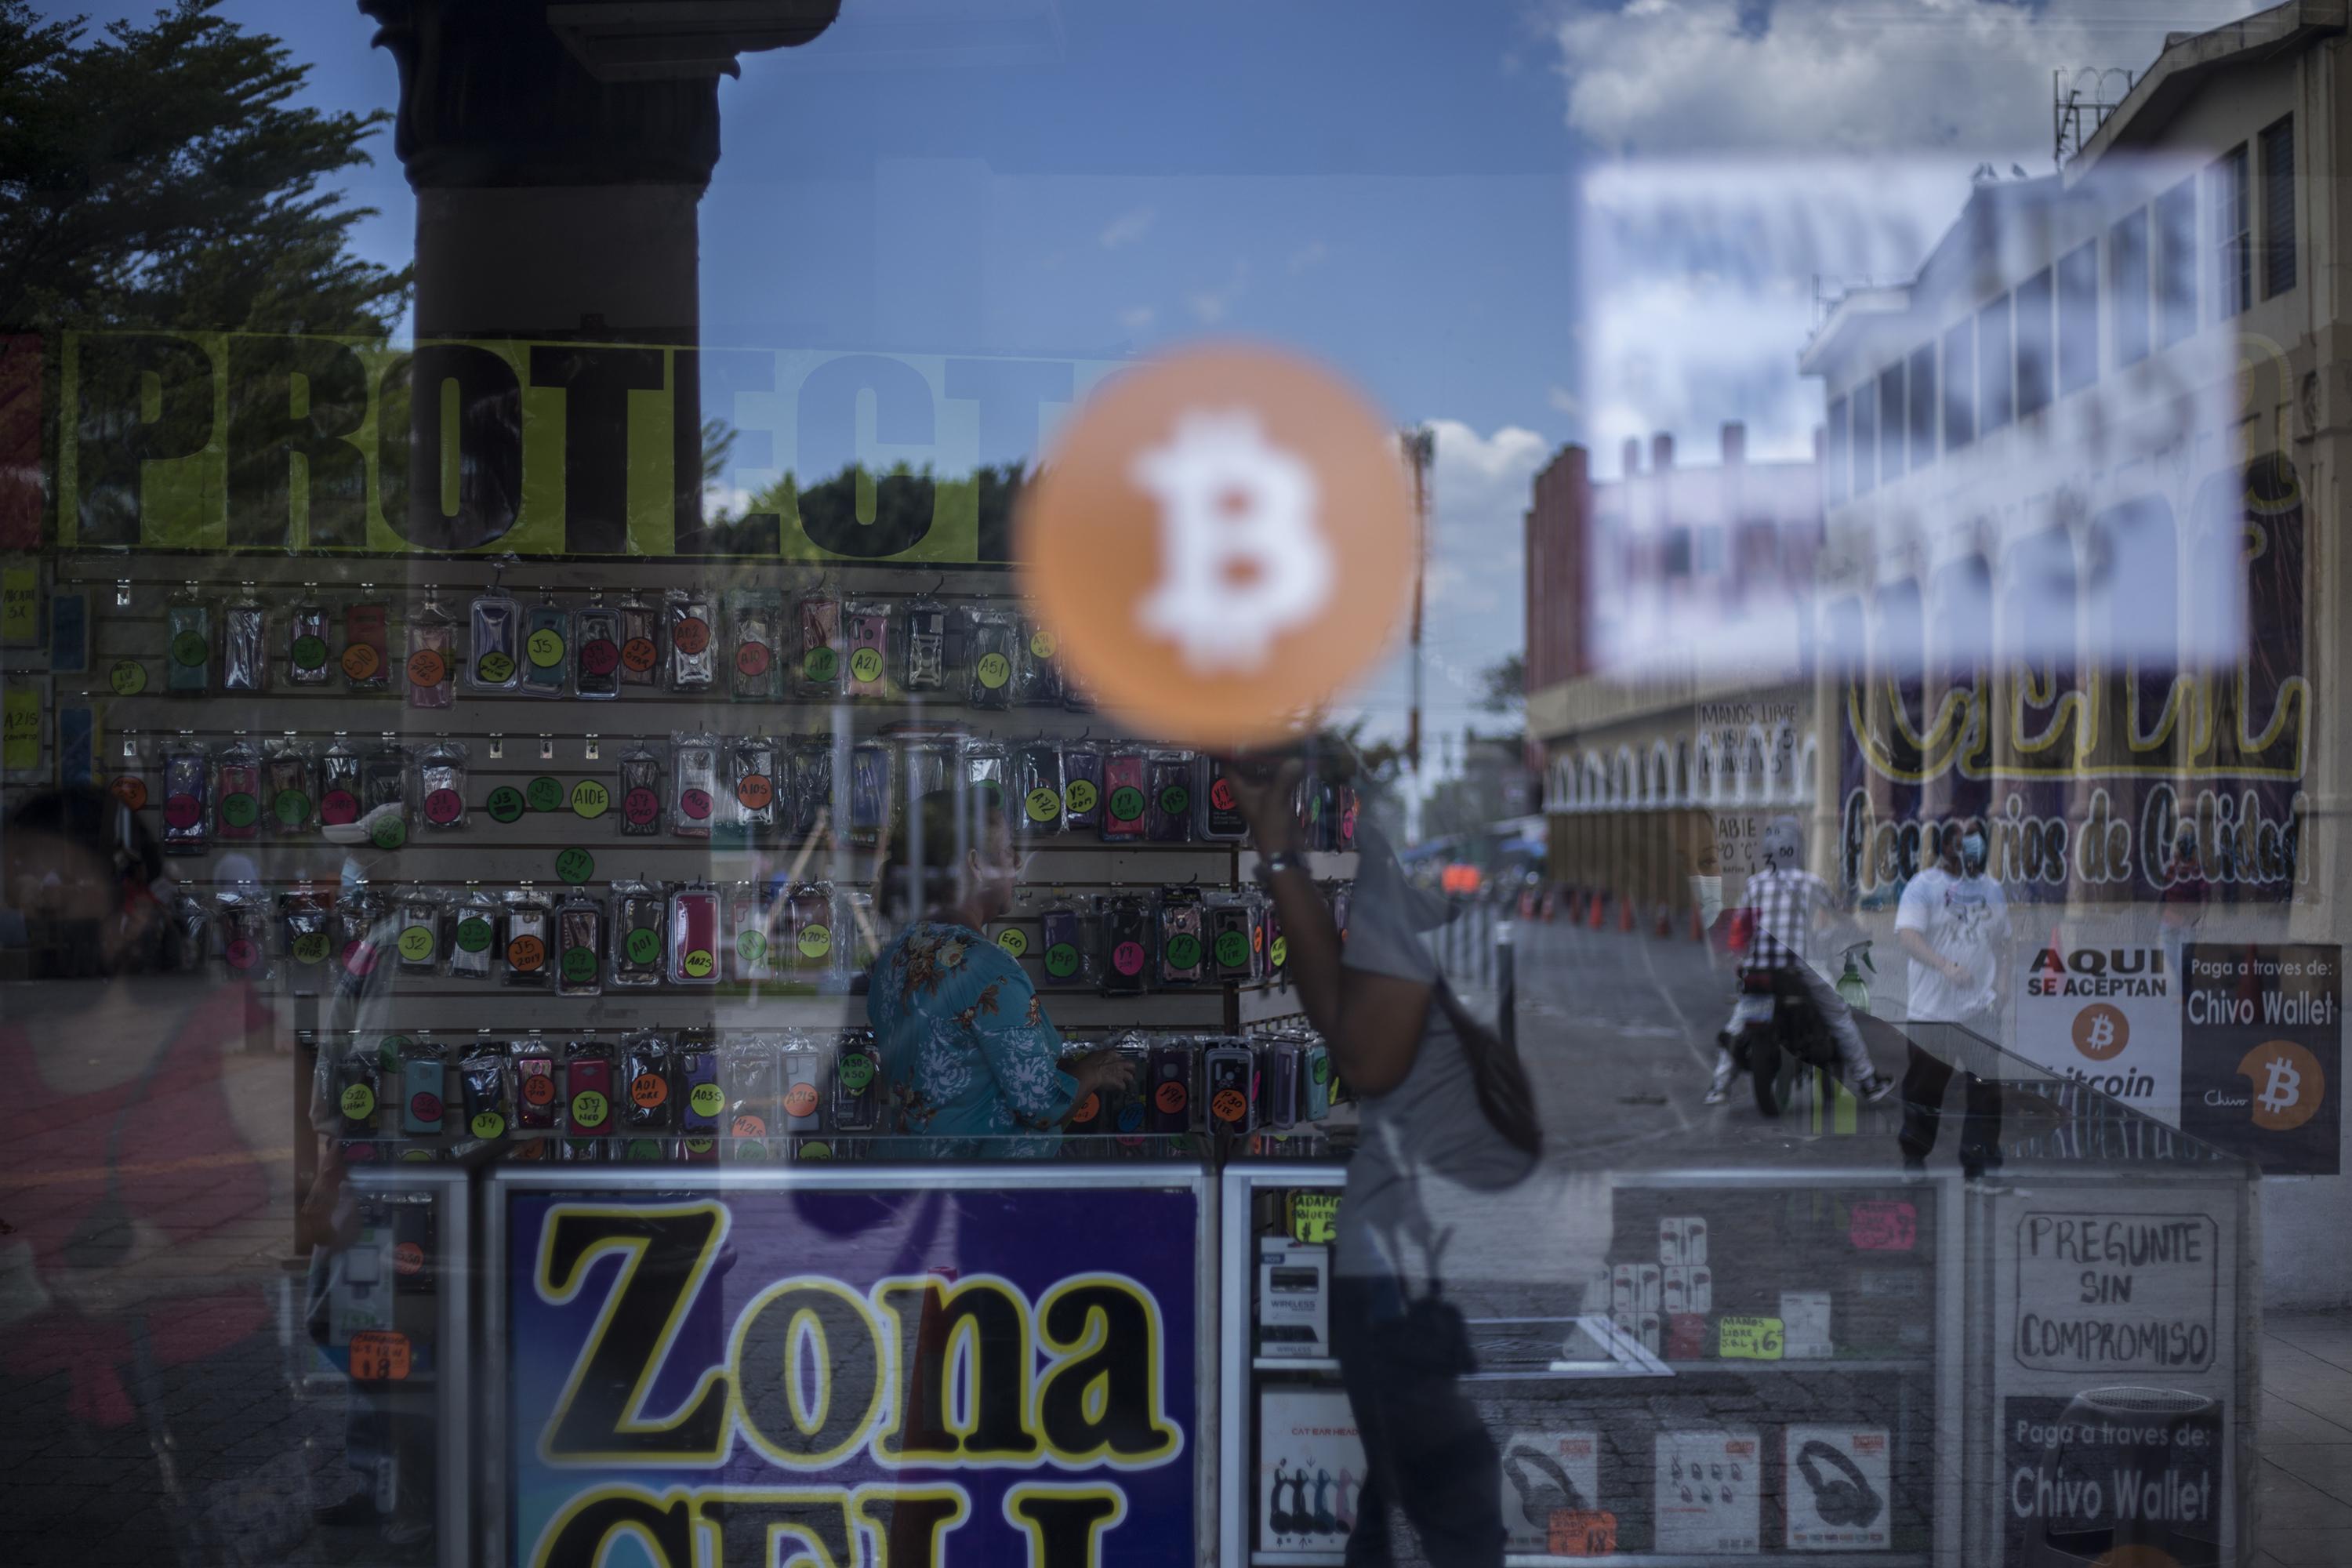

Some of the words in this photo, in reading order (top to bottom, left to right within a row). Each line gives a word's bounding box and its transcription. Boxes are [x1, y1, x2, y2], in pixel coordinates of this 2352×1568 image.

[77, 336, 1113, 563] PROTECT
[533, 638, 553, 654] J5
[345, 646, 372, 675] S10
[741, 650, 760, 663] A10
[810, 654, 833, 672] A12
[855, 654, 877, 673] A21
[980, 658, 1005, 678] A51
[1701, 703, 1755, 724] MANOS
[1761, 703, 1796, 723] LIBRE
[494, 791, 512, 805] J3
[687, 792, 710, 812] A02
[1032, 792, 1056, 815] A72
[2076, 787, 2134, 885] de
[303, 934, 323, 949] S8
[405, 935, 426, 951] J2
[515, 940, 535, 955] J5
[631, 935, 652, 956] A01
[1002, 933, 1022, 948] ECO
[1219, 938, 1239, 952] P20
[2029, 949, 2165, 977] AQUI
[2190, 959, 2233, 978] Paga
[2238, 961, 2249, 976] a
[2253, 960, 2301, 977] traves
[2305, 960, 2332, 977] de:
[2027, 978, 2058, 997] SE
[2063, 978, 2167, 997] ACEPTAN
[2187, 989, 2256, 1025] Chivo
[2261, 991, 2335, 1026] Wallet
[635, 1079, 656, 1092] A01
[578, 1097, 601, 1112] J7
[1222, 1091, 1243, 1109] P30
[2204, 1090, 2249, 1107] Chivo
[477, 1115, 497, 1130] J4
[2029, 1216, 2202, 1267] PREGUNTE
[2080, 1270, 2132, 1303] SIN
[1271, 1300, 1316, 1308] WIRELESS
[541, 1200, 1184, 1469] Zona
[2022, 1312, 2209, 1366] COMPROMISO
[1291, 1428, 1312, 1436] CAT
[1312, 1428, 1332, 1436] EAR
[2016, 1419, 2074, 1450] Paga
[2081, 1427, 2095, 1445] a
[2102, 1421, 2169, 1446] traves
[2174, 1422, 2211, 1447] de:
[2012, 1465, 2103, 1519] Chivo
[2113, 1468, 2211, 1522] Wallet
